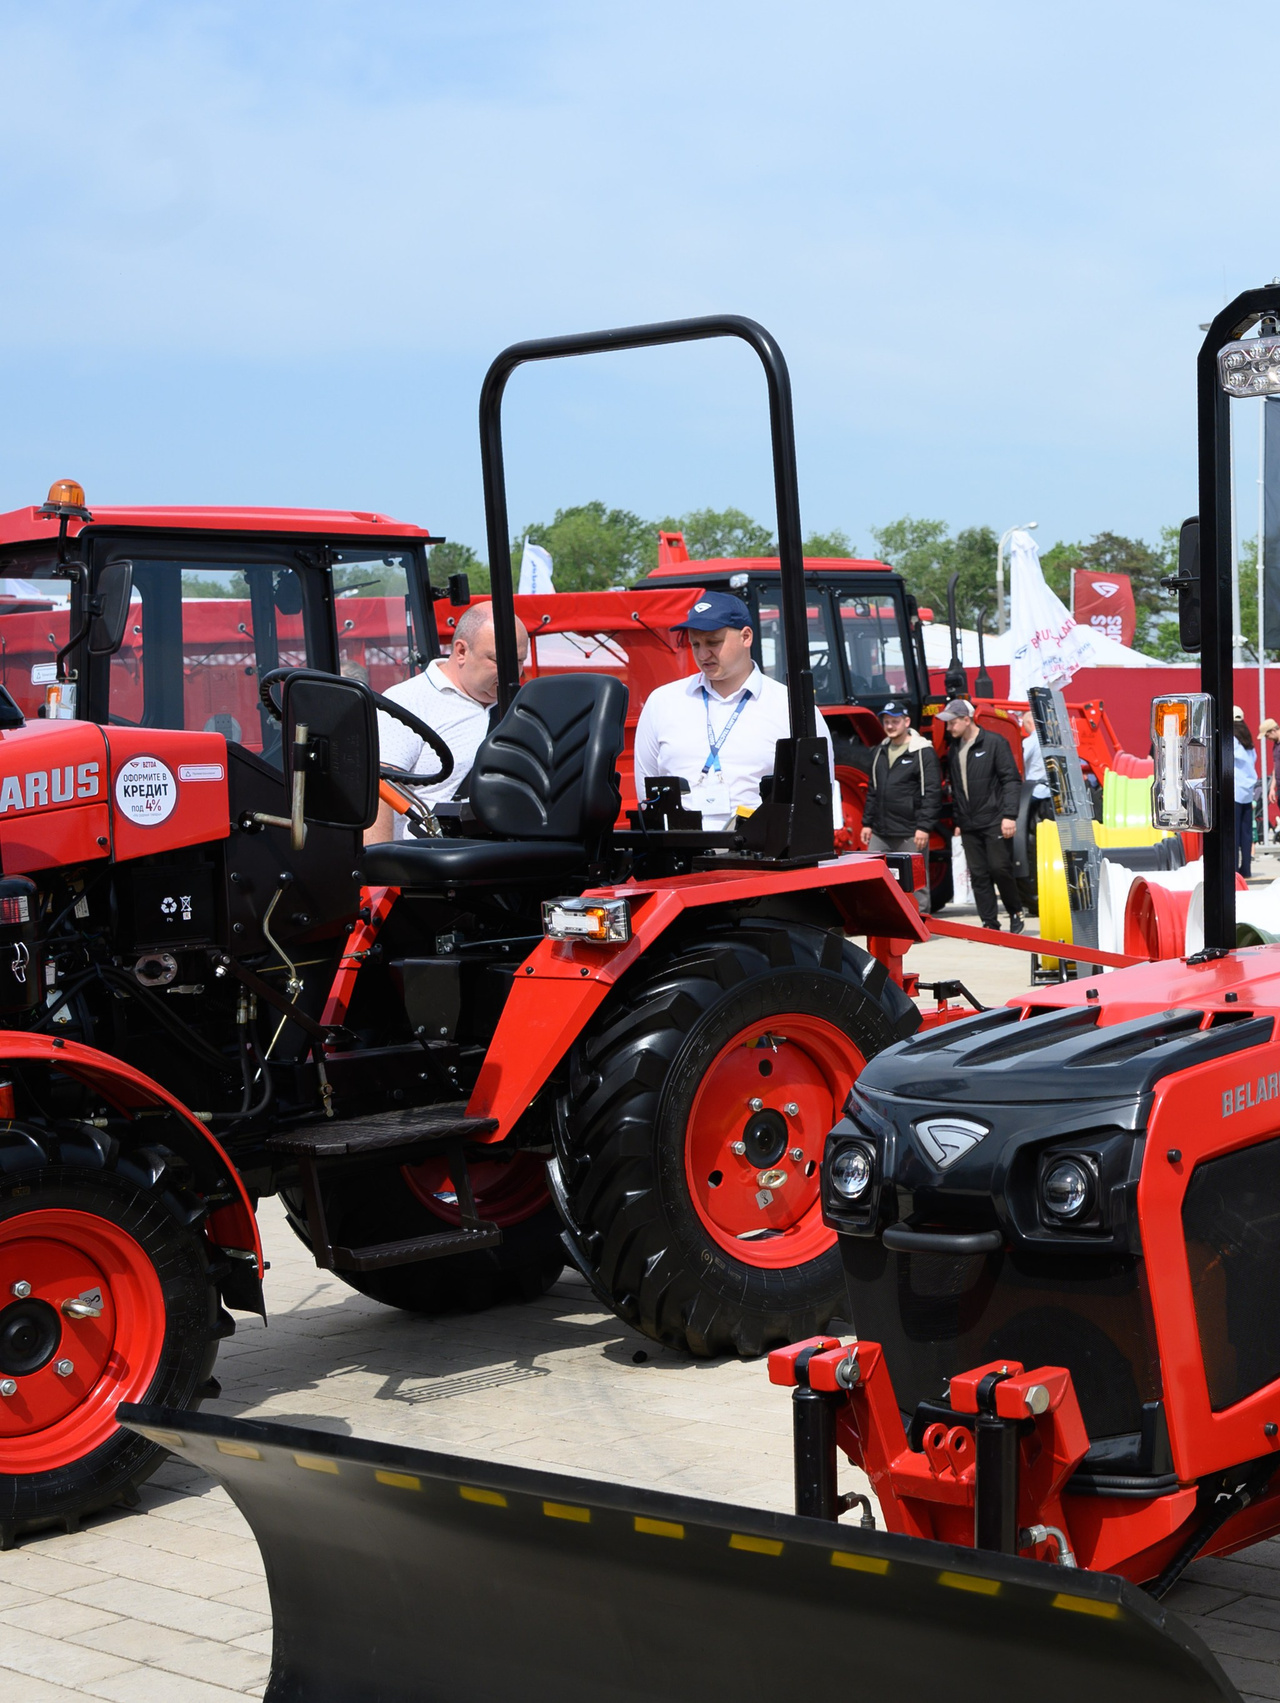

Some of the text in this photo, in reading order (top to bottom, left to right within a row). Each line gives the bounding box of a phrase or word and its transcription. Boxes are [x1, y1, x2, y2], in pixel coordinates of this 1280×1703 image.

[123, 772, 168, 783] ОФОРМИТЕ В
[0, 761, 99, 813] ARUS
[123, 783, 169, 799] КРЕДИТ
[145, 798, 162, 812] 4%
